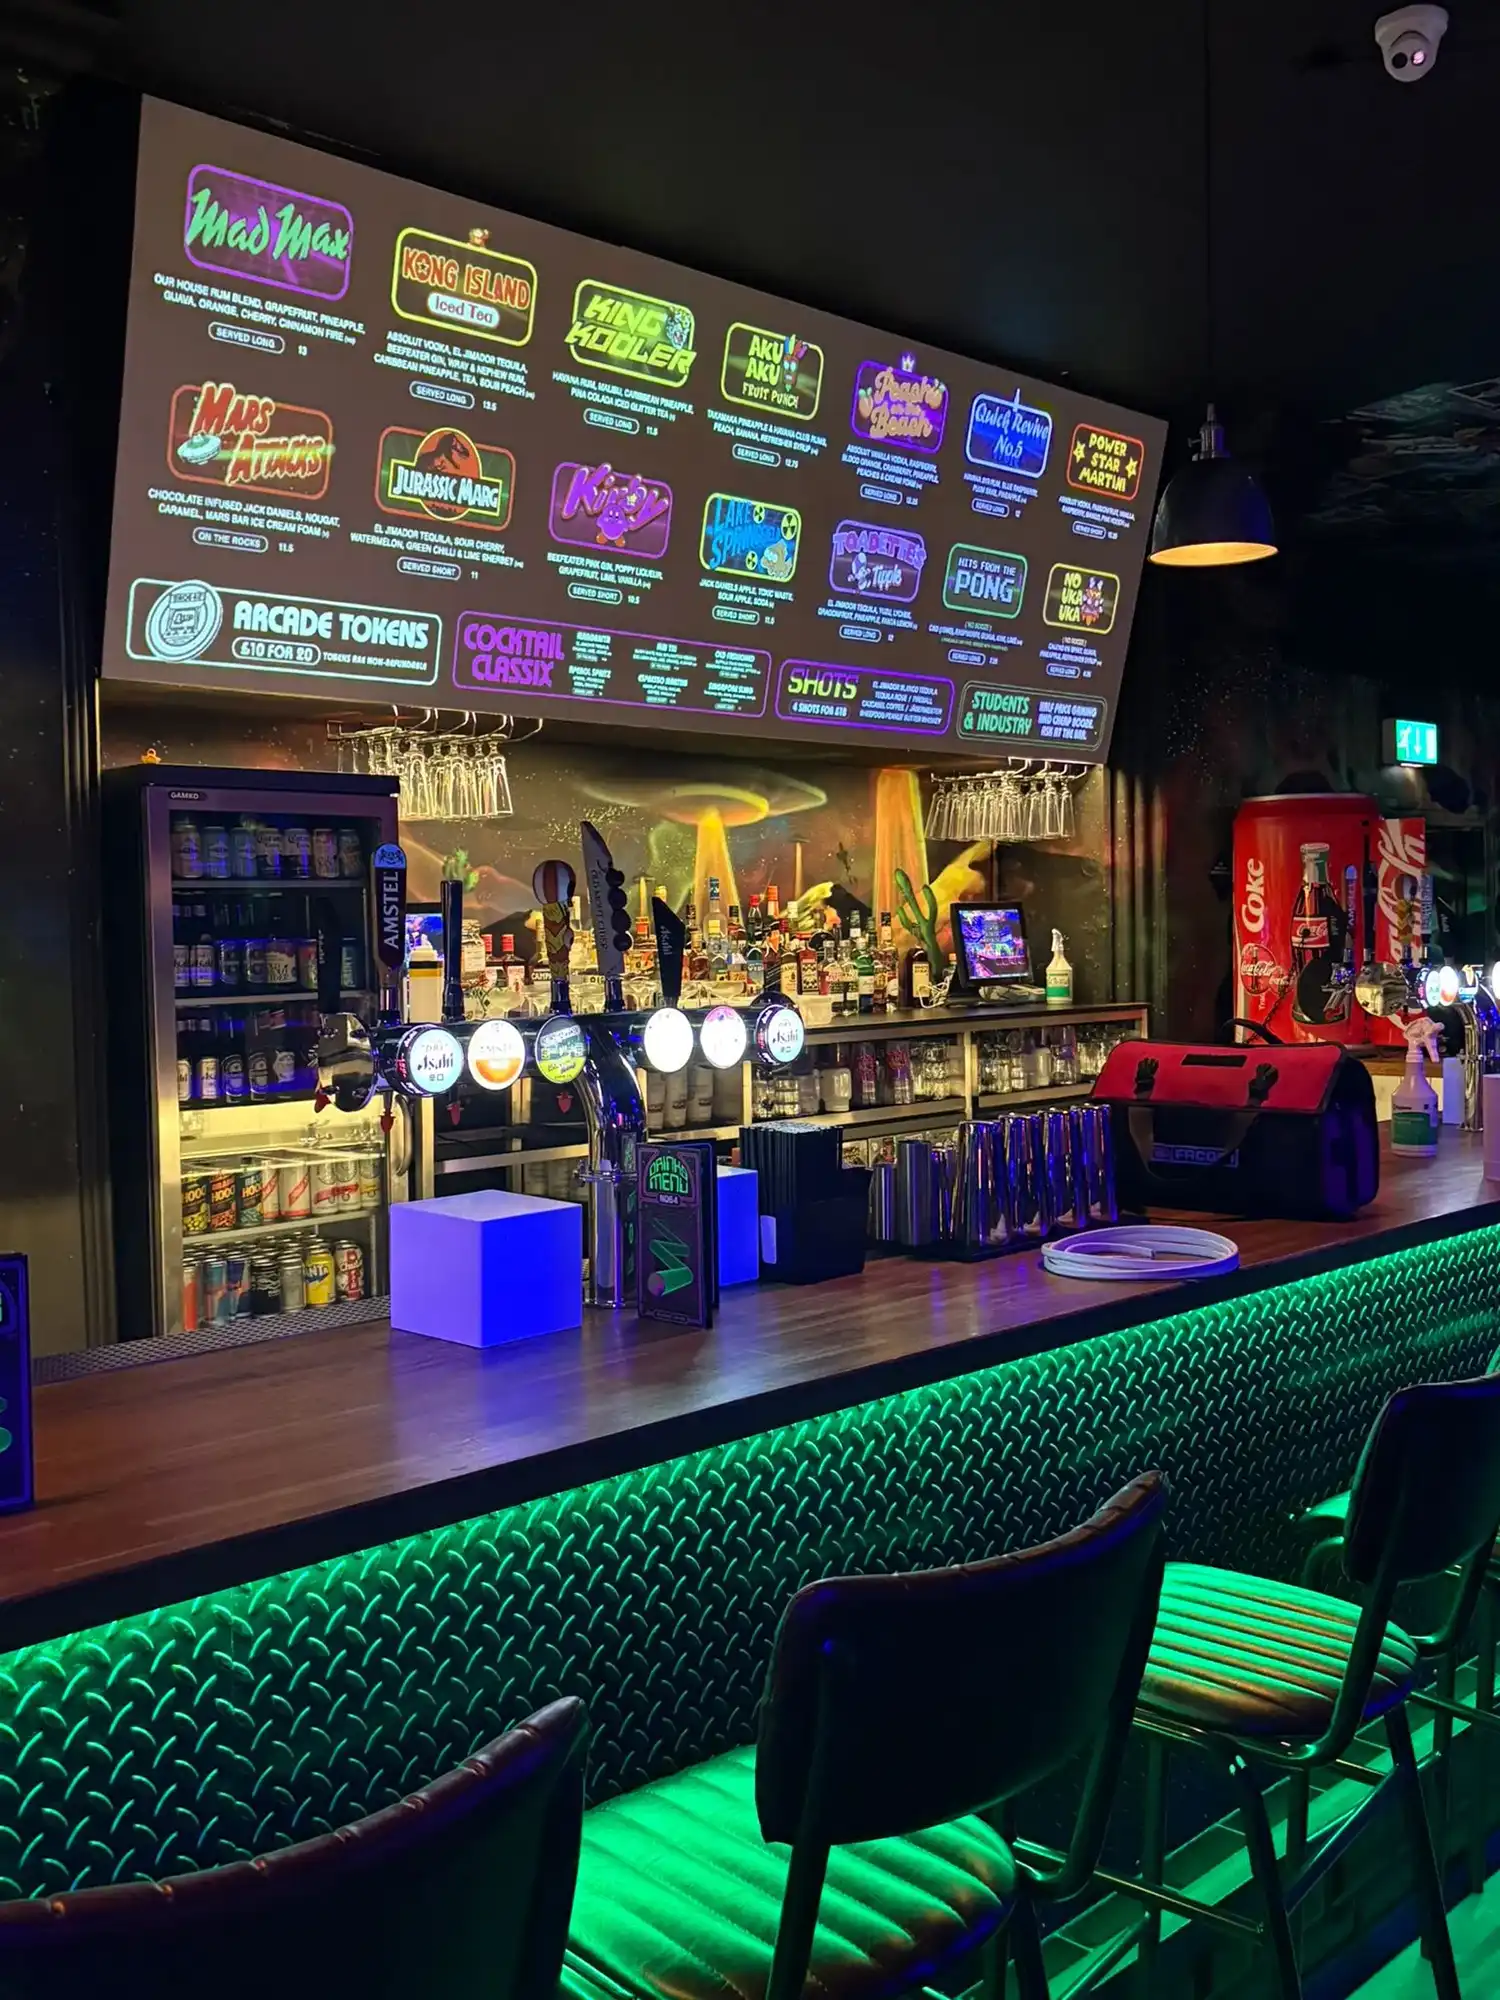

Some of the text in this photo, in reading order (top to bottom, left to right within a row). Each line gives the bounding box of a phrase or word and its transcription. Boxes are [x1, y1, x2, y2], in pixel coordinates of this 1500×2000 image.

[185, 188, 351, 261] Mad Max
[402, 246, 531, 310] KONG ISLAND
[154, 273, 366, 335] OUR HOUSE RUM BLEND, GRAPEFRUIT, PINEAPPLE,
[164, 290, 197, 308] GUAVA,
[199, 298, 239, 318] ORANGE,
[241, 307, 278, 327] CHERRY,
[279, 316, 324, 337] CINNAMON
[326, 328, 344, 342] FIRE
[435, 296, 493, 324] Iced Tea
[583, 294, 667, 337] KING
[216, 326, 276, 349] SERVED LONG
[564, 321, 697, 374] KOOLER
[748, 335, 784, 364] AKU
[298, 344, 308, 357] 13
[387, 330, 423, 348] ABSOLUT
[423, 340, 451, 356] VODKA,
[497, 357, 528, 373] TEQUILA,
[387, 343, 430, 361] BEEFEATER
[374, 353, 418, 372] CARIBBEAN
[419, 363, 461, 383] PINEAPPLE,
[480, 377, 500, 391] SOUR
[501, 382, 526, 397] PEACH
[745, 357, 781, 386] AKU
[416, 385, 467, 405] SERVED LONG
[742, 381, 799, 409] FRUIT PUNCH
[589, 412, 632, 430] SERVED LONG
[737, 446, 775, 463] SERVED LONG
[1089, 433, 1128, 457] POWER
[1090, 452, 1120, 473] STAR
[1078, 467, 1126, 493] MARTINI
[148, 487, 341, 527] CHOCOLATE INFUSED JACK DANIELS, NOUGAT,
[561, 462, 669, 532] Kirby
[158, 503, 321, 537] CARAMEL, MARS BAR ICE CREAM FOAM
[198, 531, 261, 548] ON THE ROCKS
[350, 532, 405, 550] WATERMELON,
[406, 541, 432, 553] GREEN
[433, 545, 456, 558] CHILLI
[463, 550, 480, 562] LIME
[374, 523, 384, 534] EL
[420, 530, 453, 546] TEQUILA,
[454, 536, 475, 548] SOUR
[475, 541, 505, 554] CHERRY,
[402, 561, 456, 577] SERVED SHORT
[958, 557, 1017, 577] HITS FROM THE
[954, 569, 1015, 603] PONG
[1064, 572, 1082, 588] NO
[572, 586, 618, 601] SERVED SHORT
[1061, 588, 1083, 606] UKA
[233, 600, 429, 650] ARCADE TOKENS
[1058, 604, 1081, 622] UKA
[240, 643, 313, 662] £10 FOR 20
[464, 623, 565, 660] COCKTAIL
[323, 651, 351, 663] TOKENS
[471, 654, 554, 688] CLASSIX
[787, 668, 860, 700] SHOTS
[792, 702, 798, 711] 4
[798, 703, 820, 715] SHOTS
[820, 705, 834, 716] FOR
[972, 691, 1030, 715] STUDENTS
[1039, 701, 1054, 713] HALF
[1054, 703, 1071, 715] PRICE
[963, 712, 1033, 736] & INDUSTRY
[1038, 713, 1052, 725] AND
[1053, 715, 1071, 727] CHEAP
[1041, 725, 1053, 737] ASK
[1053, 727, 1062, 738] AT
[1241, 857, 1266, 934] Coke
[383, 871, 400, 949] AMSTEL
[417, 1052, 454, 1071] Asahi
[649, 1156, 688, 1181] DRINKS
[649, 1172, 689, 1194] MENU
